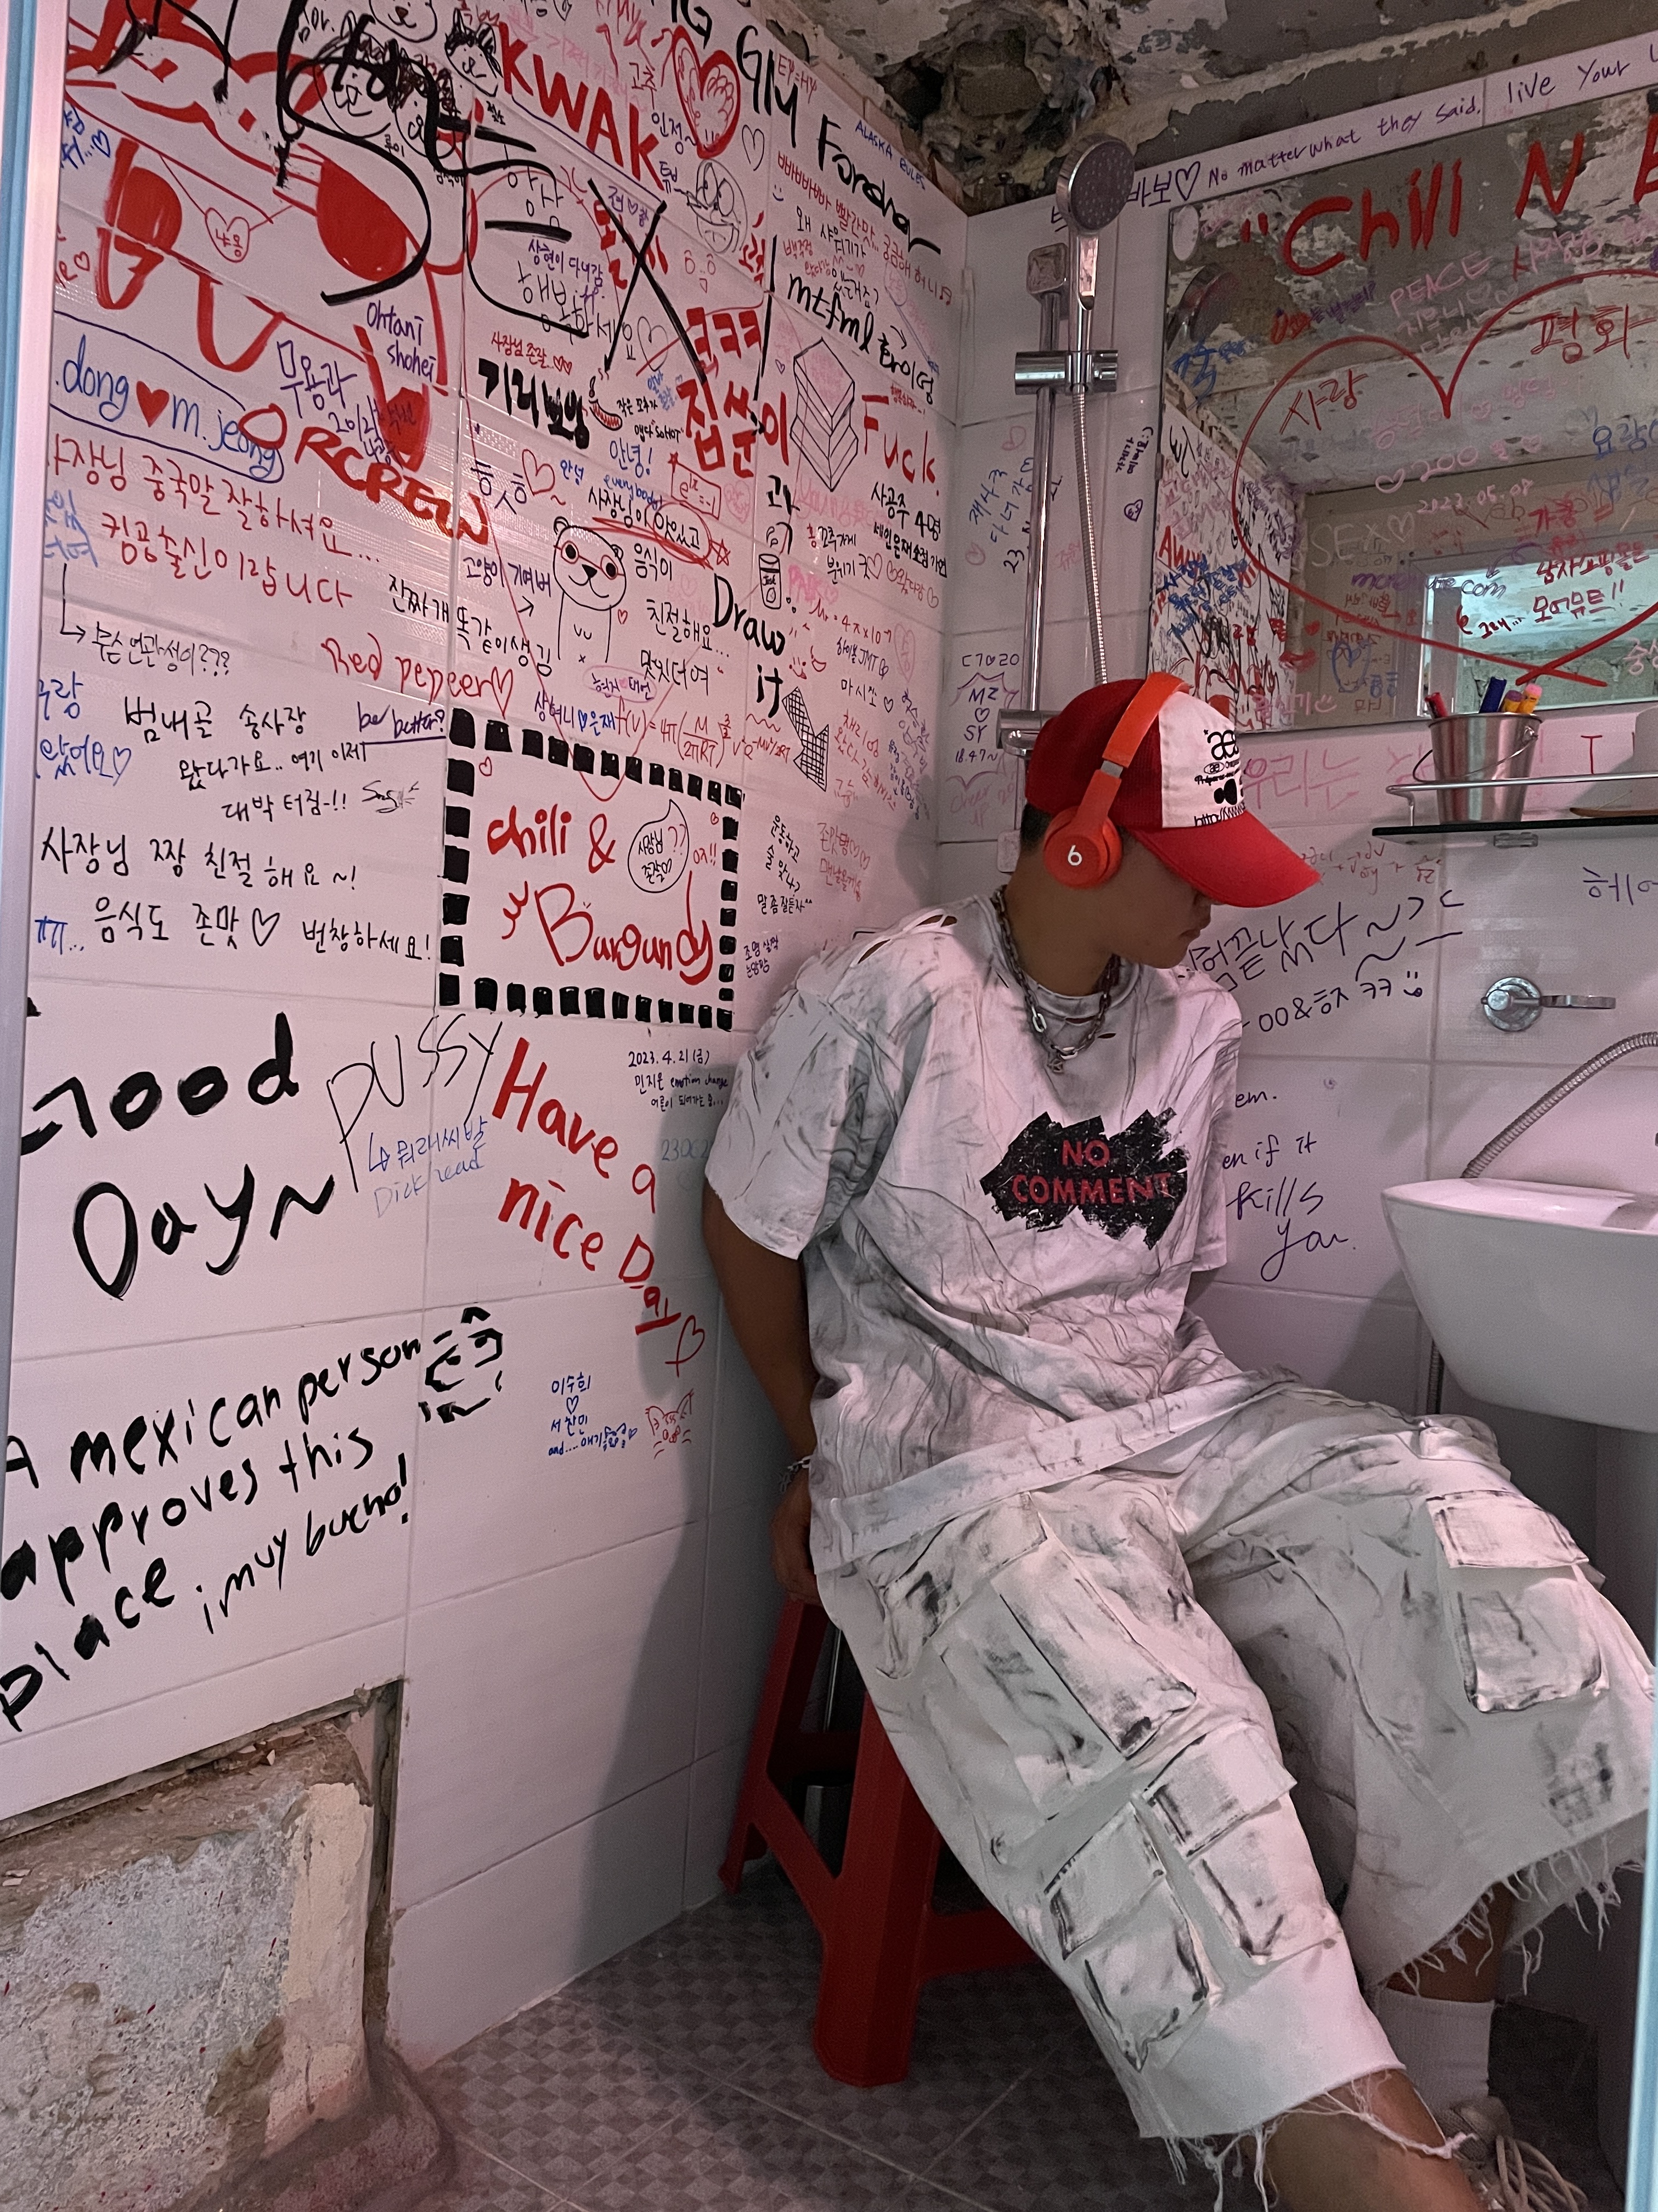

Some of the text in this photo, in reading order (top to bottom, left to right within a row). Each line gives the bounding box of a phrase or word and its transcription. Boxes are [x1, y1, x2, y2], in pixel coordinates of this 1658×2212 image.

[499, 21, 664, 191] KWAK
[1508, 72, 1555, 104] live
[854, 119, 893, 160] ALASKA
[1208, 166, 1228, 188] No
[1238, 145, 1307, 177] matter
[1310, 129, 1362, 159] what
[1378, 110, 1422, 137] they
[1514, 132, 1585, 220] N
[366, 302, 424, 340] Ohtani
[1528, 303, 1658, 365] 평화
[277, 340, 357, 419] 무용과
[1279, 368, 1369, 435] 사랑
[1310, 520, 1386, 568] SEX
[714, 572, 786, 657] Draw
[320, 633, 385, 681] Red
[238, 703, 307, 741] 송사장
[755, 664, 784, 719] it
[291, 749, 324, 773] 여기
[221, 794, 274, 823] 대박
[487, 803, 617, 874] chili &
[41, 825, 187, 877] 사장님 짱
[93, 895, 170, 943] 음식도
[534, 870, 714, 986] Burgundy
[325, 1013, 503, 1193] PUSSY
[491, 1036, 619, 1180] Have
[1061, 1138, 1112, 1170] NO
[1256, 1134, 1279, 1167] if
[1010, 1171, 1173, 1207] COMMENT
[497, 1177, 604, 1273] nice
[3, 1434, 40, 1489] A
[296, 1338, 422, 1424] person
[0, 1426, 374, 1607] approves this
[0, 1557, 176, 1733] place
